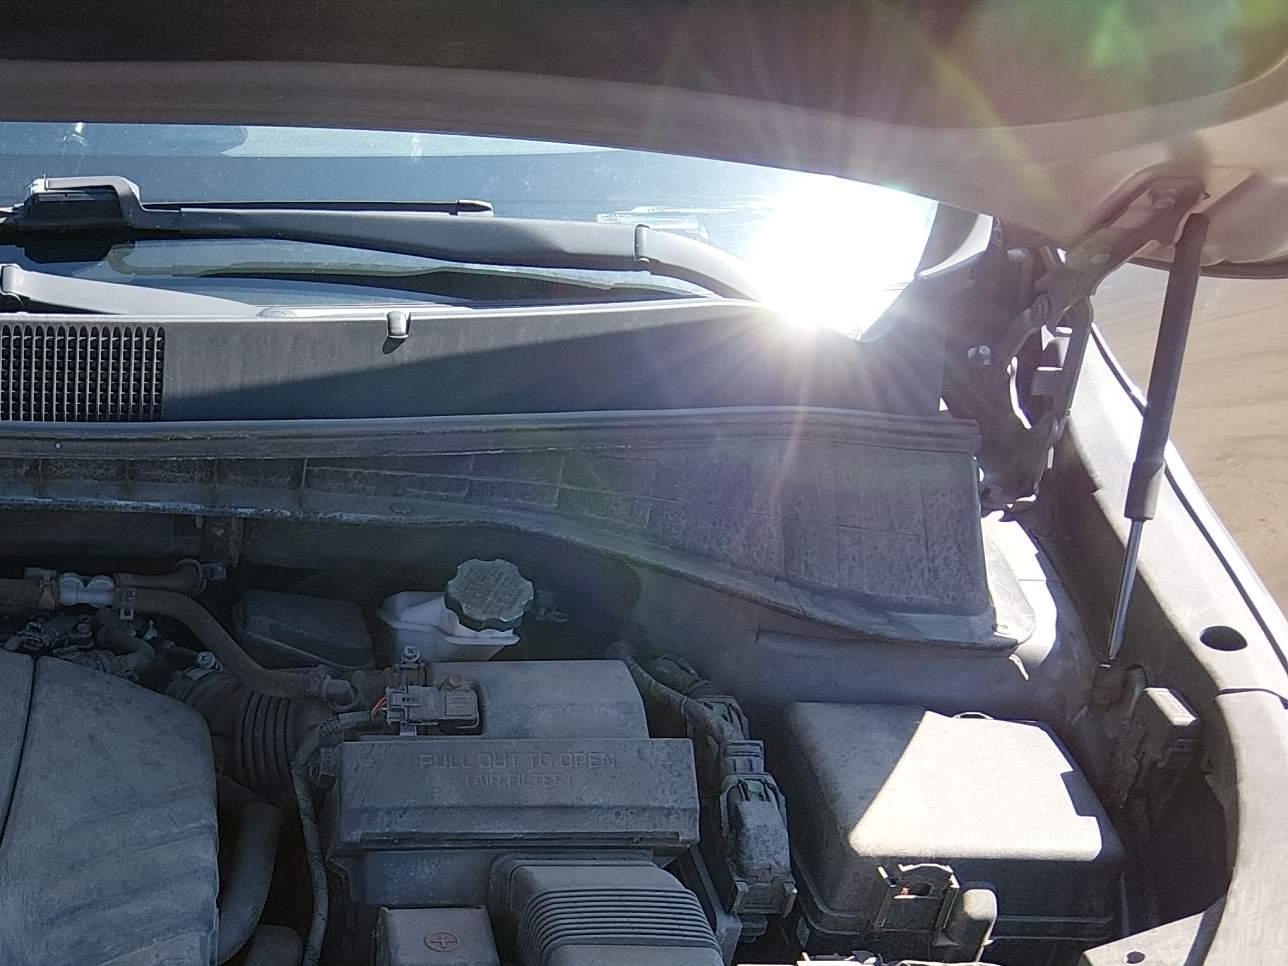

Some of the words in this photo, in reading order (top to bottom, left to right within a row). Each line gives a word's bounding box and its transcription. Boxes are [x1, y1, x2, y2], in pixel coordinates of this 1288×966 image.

[419, 752, 473, 769] PULL
[478, 752, 518, 769] OUT
[527, 752, 553, 769] TO
[559, 752, 617, 769] OPEN
